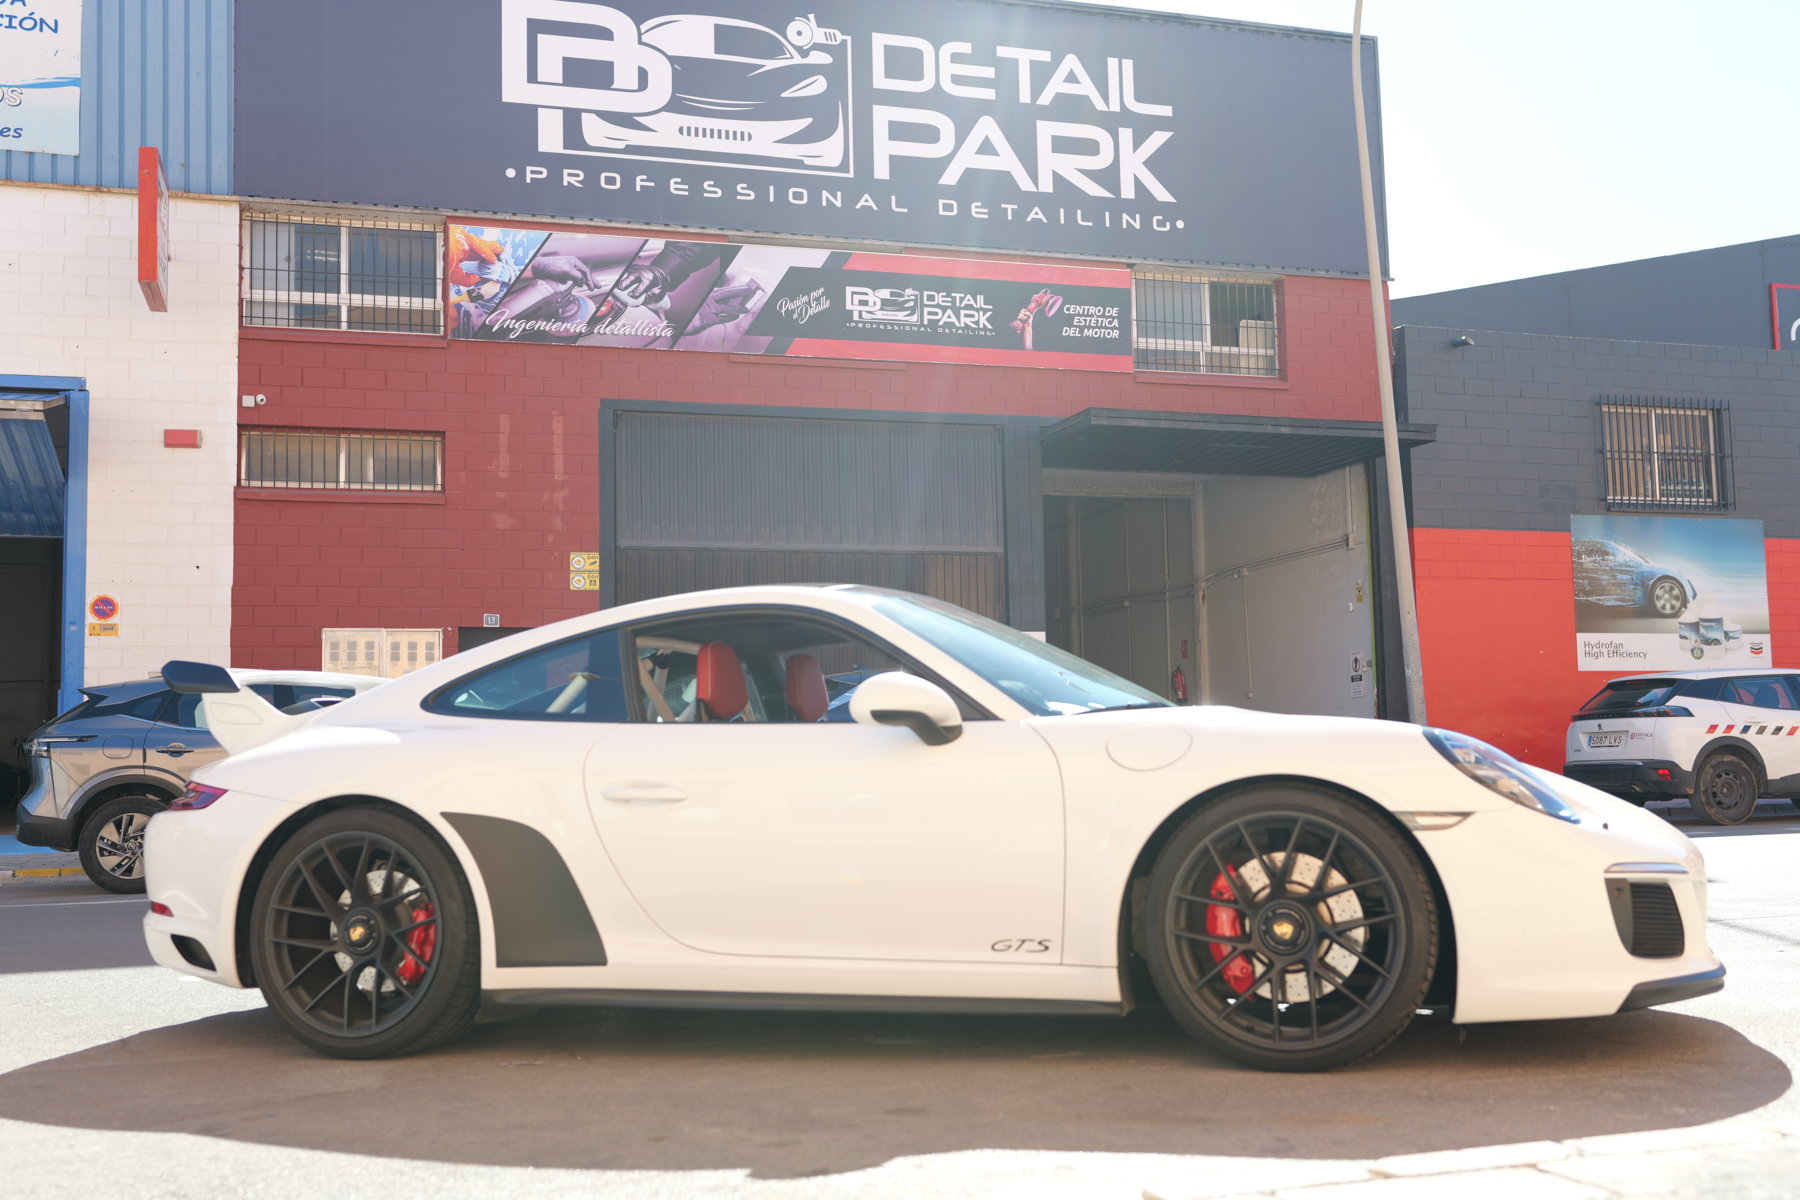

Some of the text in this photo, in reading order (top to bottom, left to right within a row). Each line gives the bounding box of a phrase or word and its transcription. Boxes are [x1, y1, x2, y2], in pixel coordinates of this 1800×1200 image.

[872, 32, 1173, 117] DETAIL
[873, 104, 1177, 203] PARK
[525, 165, 1170, 231] PROFESSIONAL DETAILING
[776, 287, 825, 317] Pasión por
[923, 290, 993, 309] DETAIL
[798, 295, 831, 324] Detalle
[1063, 304, 1119, 317] CENTRO DE
[923, 307, 993, 329] PARK
[1073, 315, 1119, 328] ESTÉTICA
[593, 317, 675, 338] detallista
[850, 322, 991, 336] PROFESSIONAL DETAILING
[1062, 326, 1120, 339] DEL MOTOR
[487, 616, 496, 625] 13
[1583, 640, 1624, 650] Hydrofan
[1584, 649, 1648, 660] High Efficiency
[1591, 735, 1622, 745] 5087 LVS
[991, 938, 1052, 953] GTS
